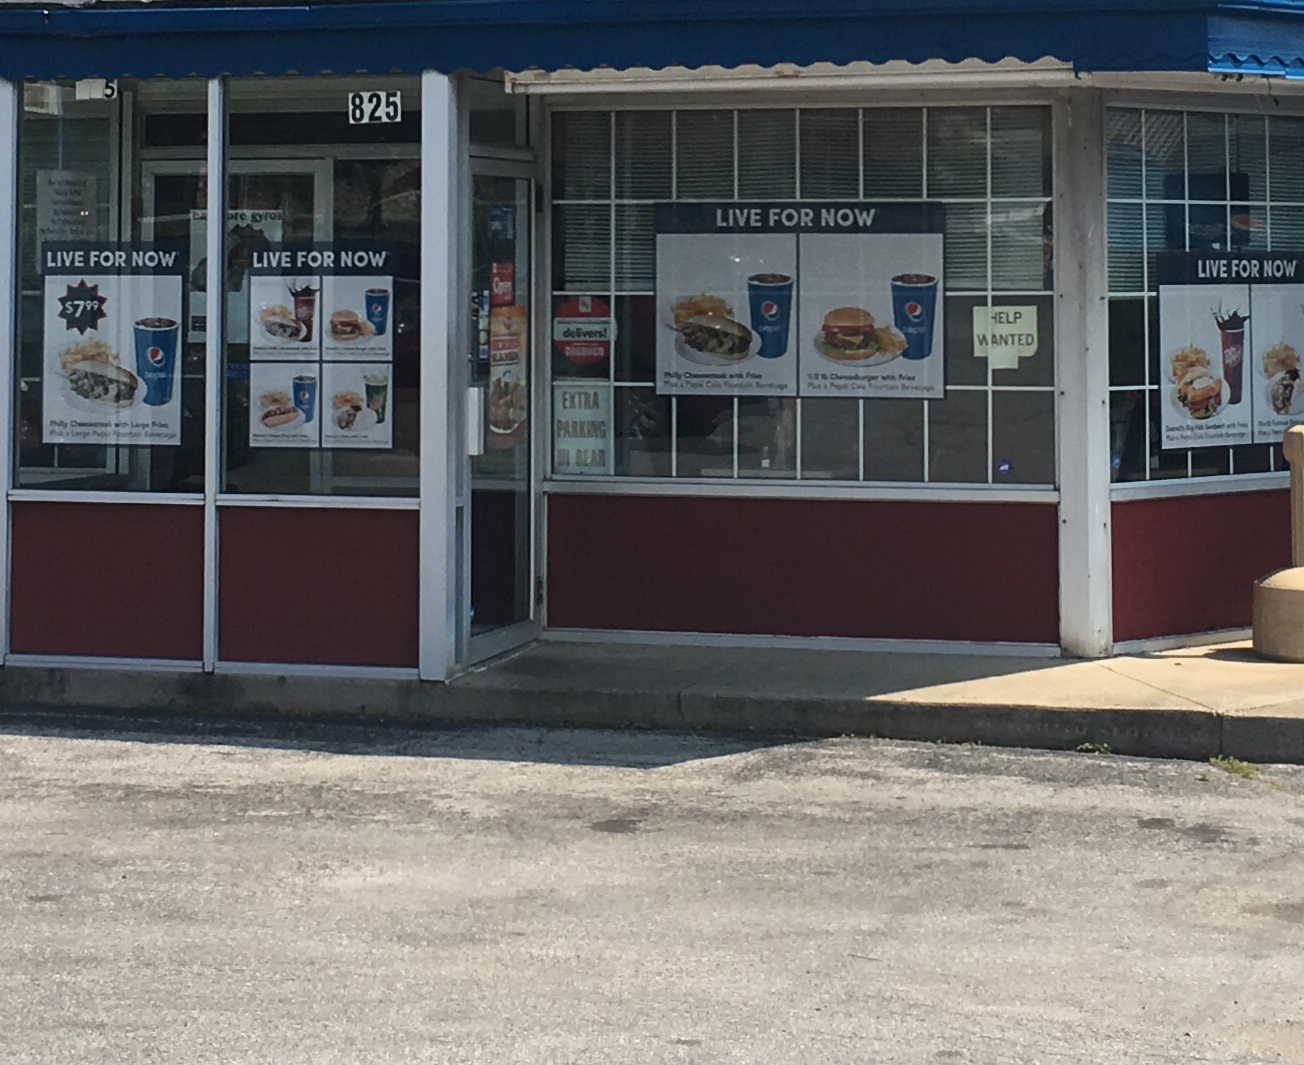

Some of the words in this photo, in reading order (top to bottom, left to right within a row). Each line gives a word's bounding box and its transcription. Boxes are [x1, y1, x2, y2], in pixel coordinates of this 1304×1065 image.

[350, 91, 400, 124] 825
[716, 208, 762, 227] LIVE
[769, 208, 814, 226] FOR
[821, 208, 876, 226] NOW
[47, 251, 85, 268] LIVE
[89, 251, 126, 268] FOR
[132, 251, 176, 268] NOW
[253, 251, 292, 268] LIVE
[296, 251, 335, 268] FOR
[340, 250, 387, 268] NOW
[1198, 259, 1227, 278] LIVE
[1231, 259, 1260, 278] FOR
[1263, 259, 1297, 278] NOW
[976, 333, 1035, 347] WANTED
[562, 391, 600, 409] EXTRA
[556, 420, 607, 439] PARKING
[575, 448, 606, 467] REAR
